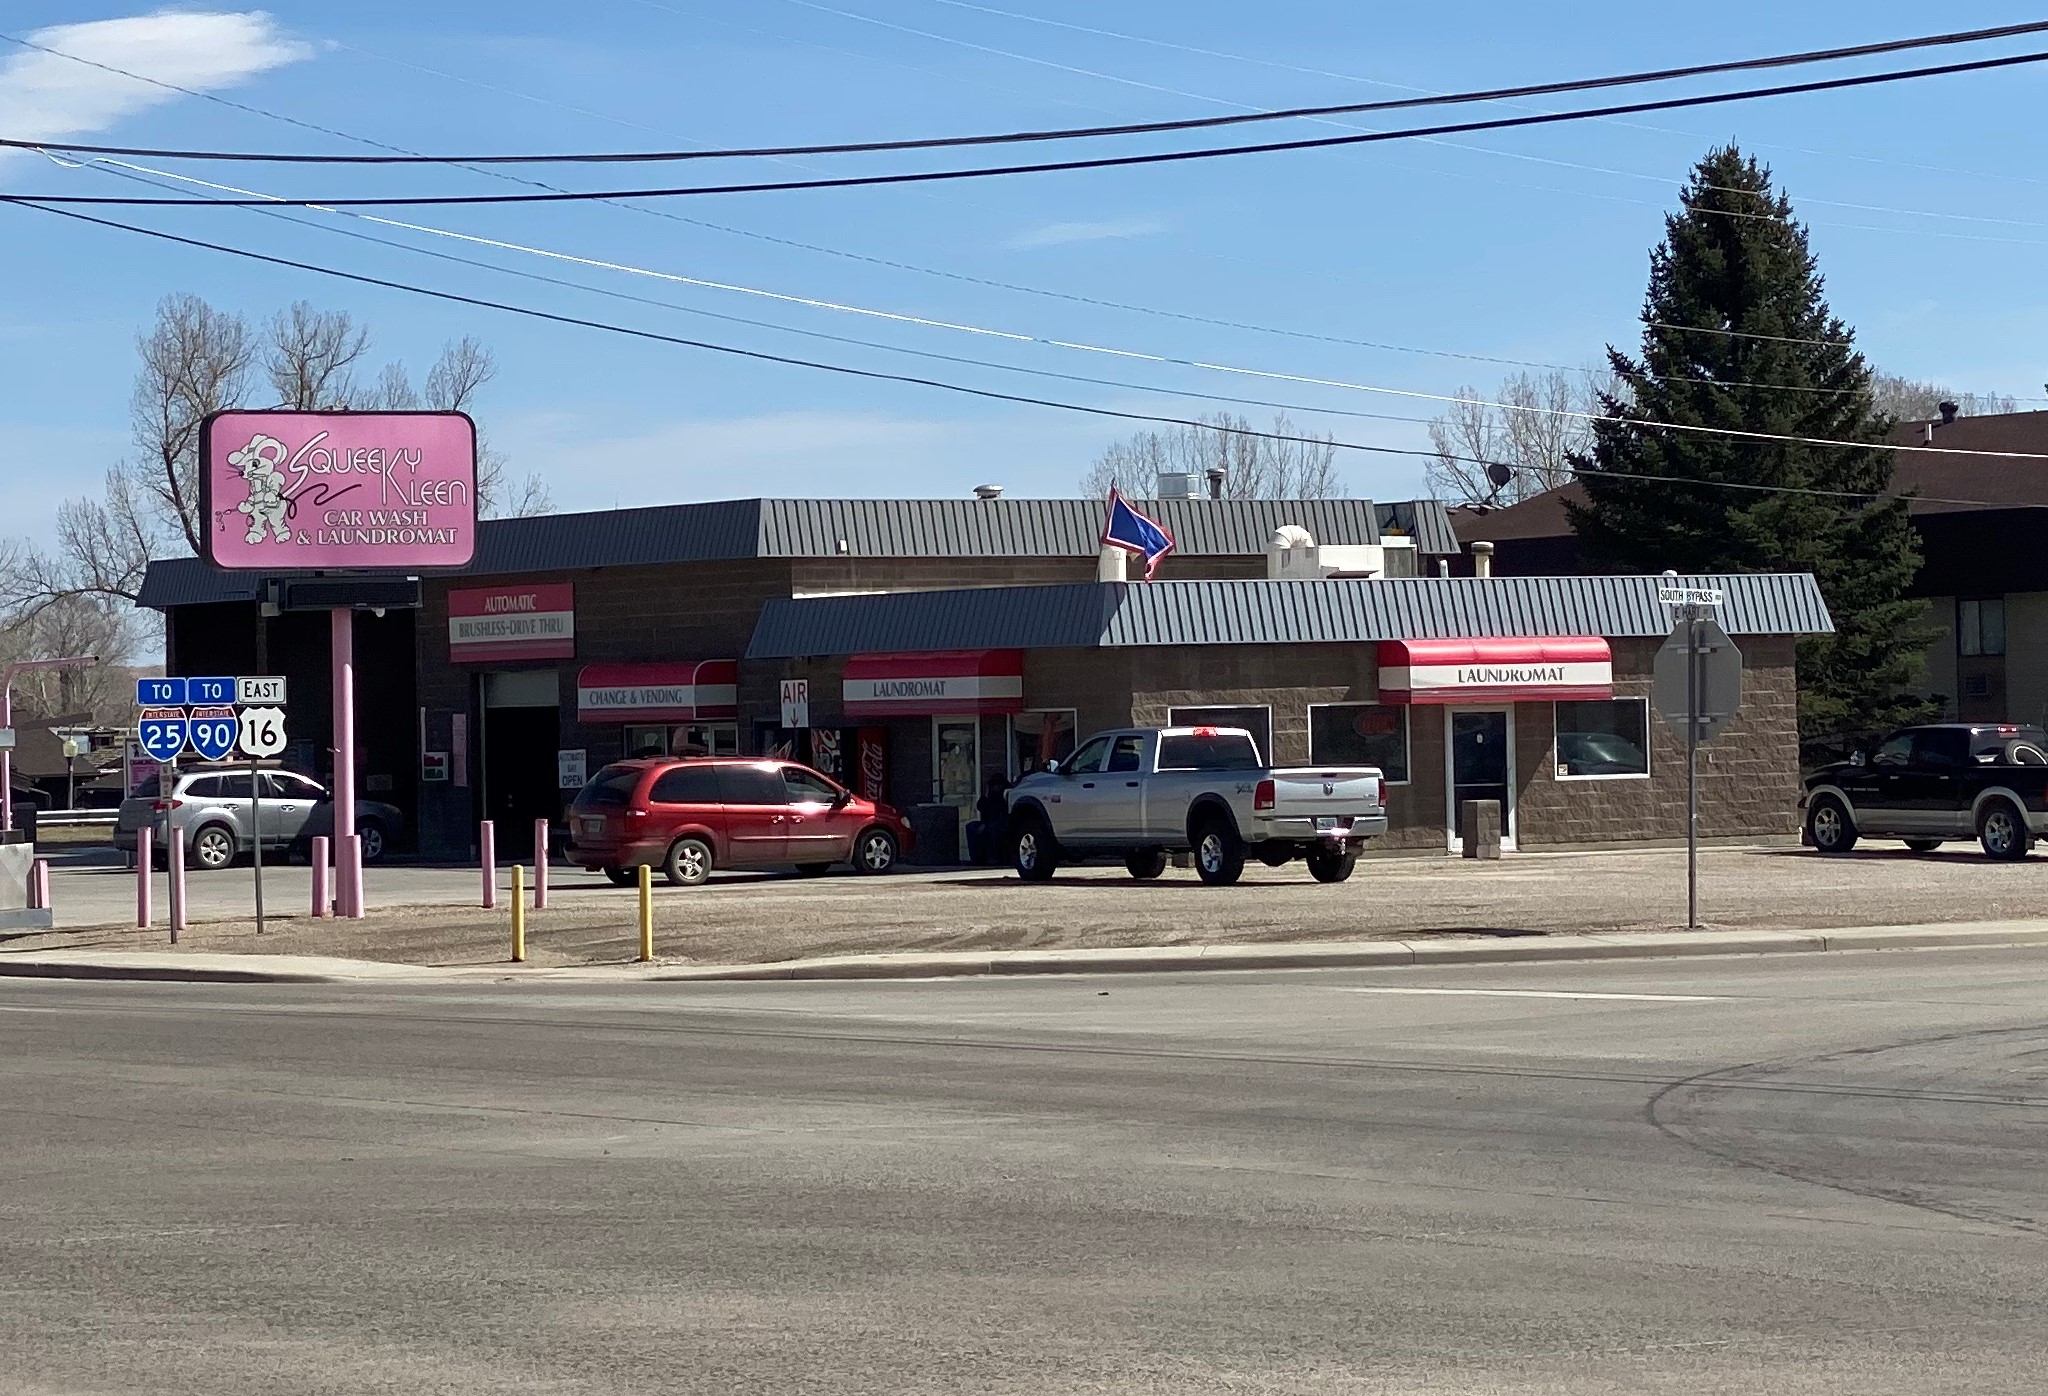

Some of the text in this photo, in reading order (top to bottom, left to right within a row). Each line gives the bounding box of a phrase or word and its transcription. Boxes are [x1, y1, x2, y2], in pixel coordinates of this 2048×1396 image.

[323, 509, 428, 526] CAR WASH
[296, 528, 458, 545] & LAUNDROMAT
[484, 594, 537, 612] AUTOMATIC
[1660, 589, 1684, 601] SOUTH
[1686, 590, 1713, 602] BYPASS
[1674, 607, 1680, 618] E
[539, 618, 564, 633] THRU
[1458, 666, 1565, 683] LAUNDROMAT
[152, 684, 172, 699] TO
[202, 683, 222, 698] TO
[244, 681, 279, 698] EAST
[589, 689, 683, 705] CHANGE & VENDING
[782, 682, 806, 703] AIR
[873, 681, 946, 697] LAUNDROMAT
[147, 725, 181, 749] 25
[197, 723, 230, 748] 90
[249, 719, 277, 746] 16
